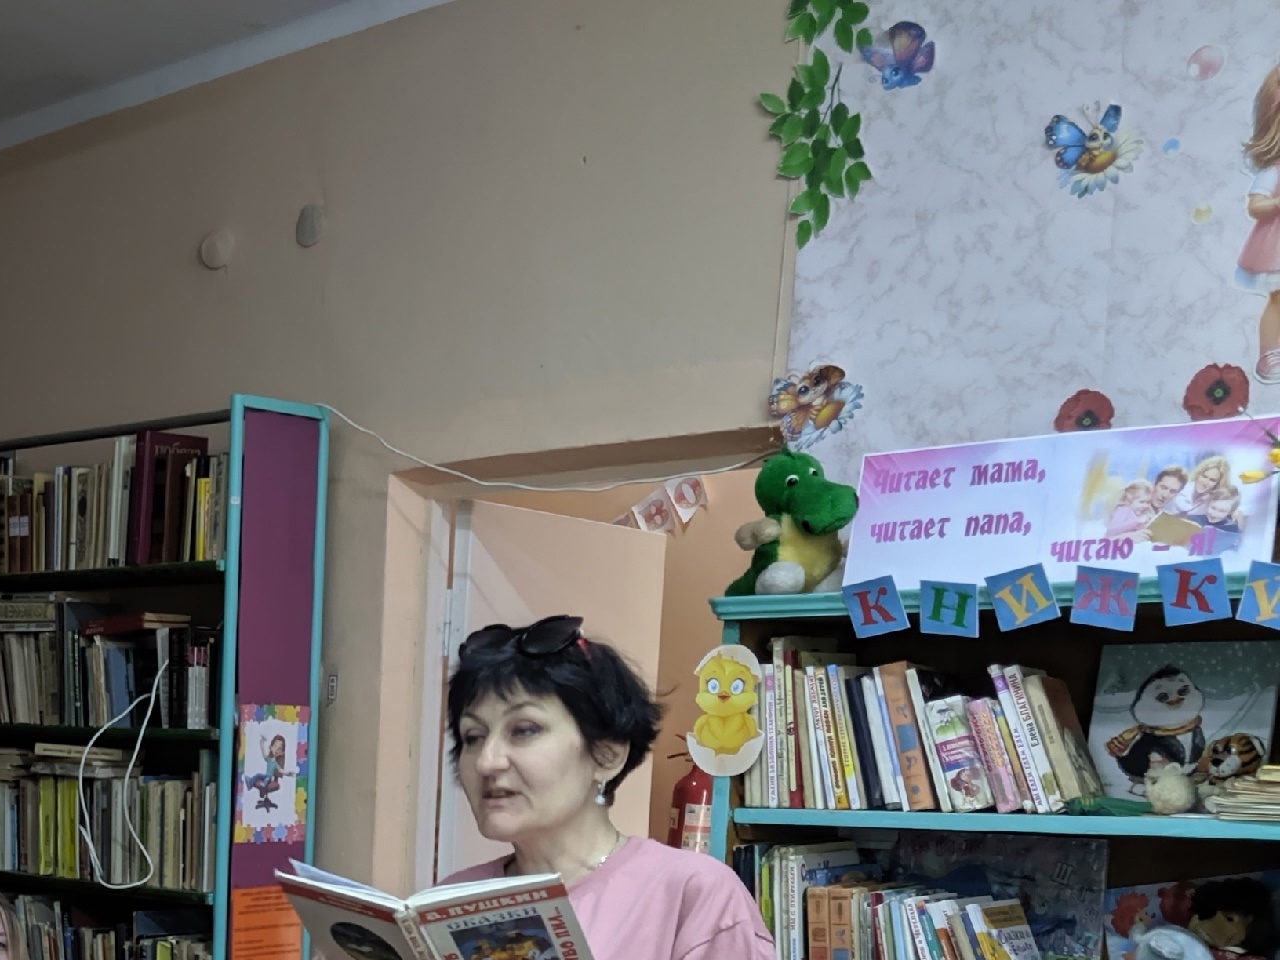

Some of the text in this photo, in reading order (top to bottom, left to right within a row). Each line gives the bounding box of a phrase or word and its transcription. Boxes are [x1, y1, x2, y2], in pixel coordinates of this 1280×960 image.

[872, 457, 1046, 496] Читает мама,
[869, 508, 1032, 545] читает папа,
[1049, 535, 1134, 564] читаю
[1007, 672, 1040, 748] Елена БЛАГИНИНА
[446, 906, 538, 930] СКАЗКИ
[447, 889, 549, 917] ПУШКИН
